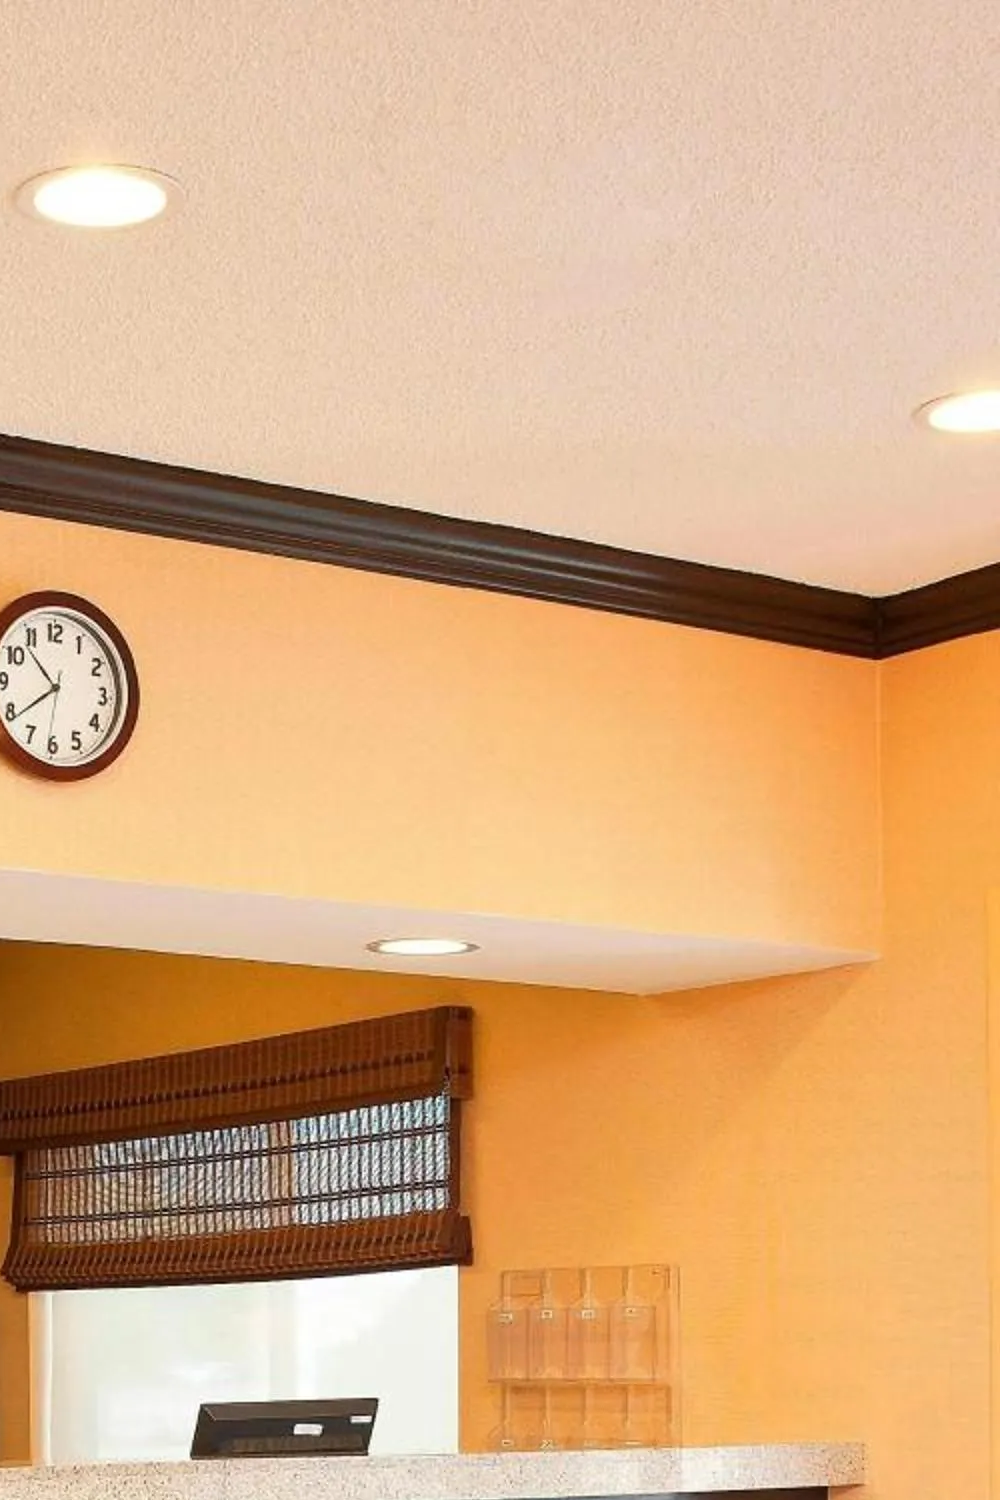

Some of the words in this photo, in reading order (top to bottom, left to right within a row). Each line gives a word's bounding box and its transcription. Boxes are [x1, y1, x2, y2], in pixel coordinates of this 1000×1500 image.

[26, 628, 37, 648] 11
[47, 623, 63, 644] 12
[7, 646, 25, 666] 10
[91, 658, 101, 676] 2
[98, 687, 107, 706] 3
[5, 702, 15, 722] 8
[89, 713, 100, 732] 4
[26, 725, 36, 744] 7
[71, 731, 81, 751] 5
[48, 736, 59, 754] 6
